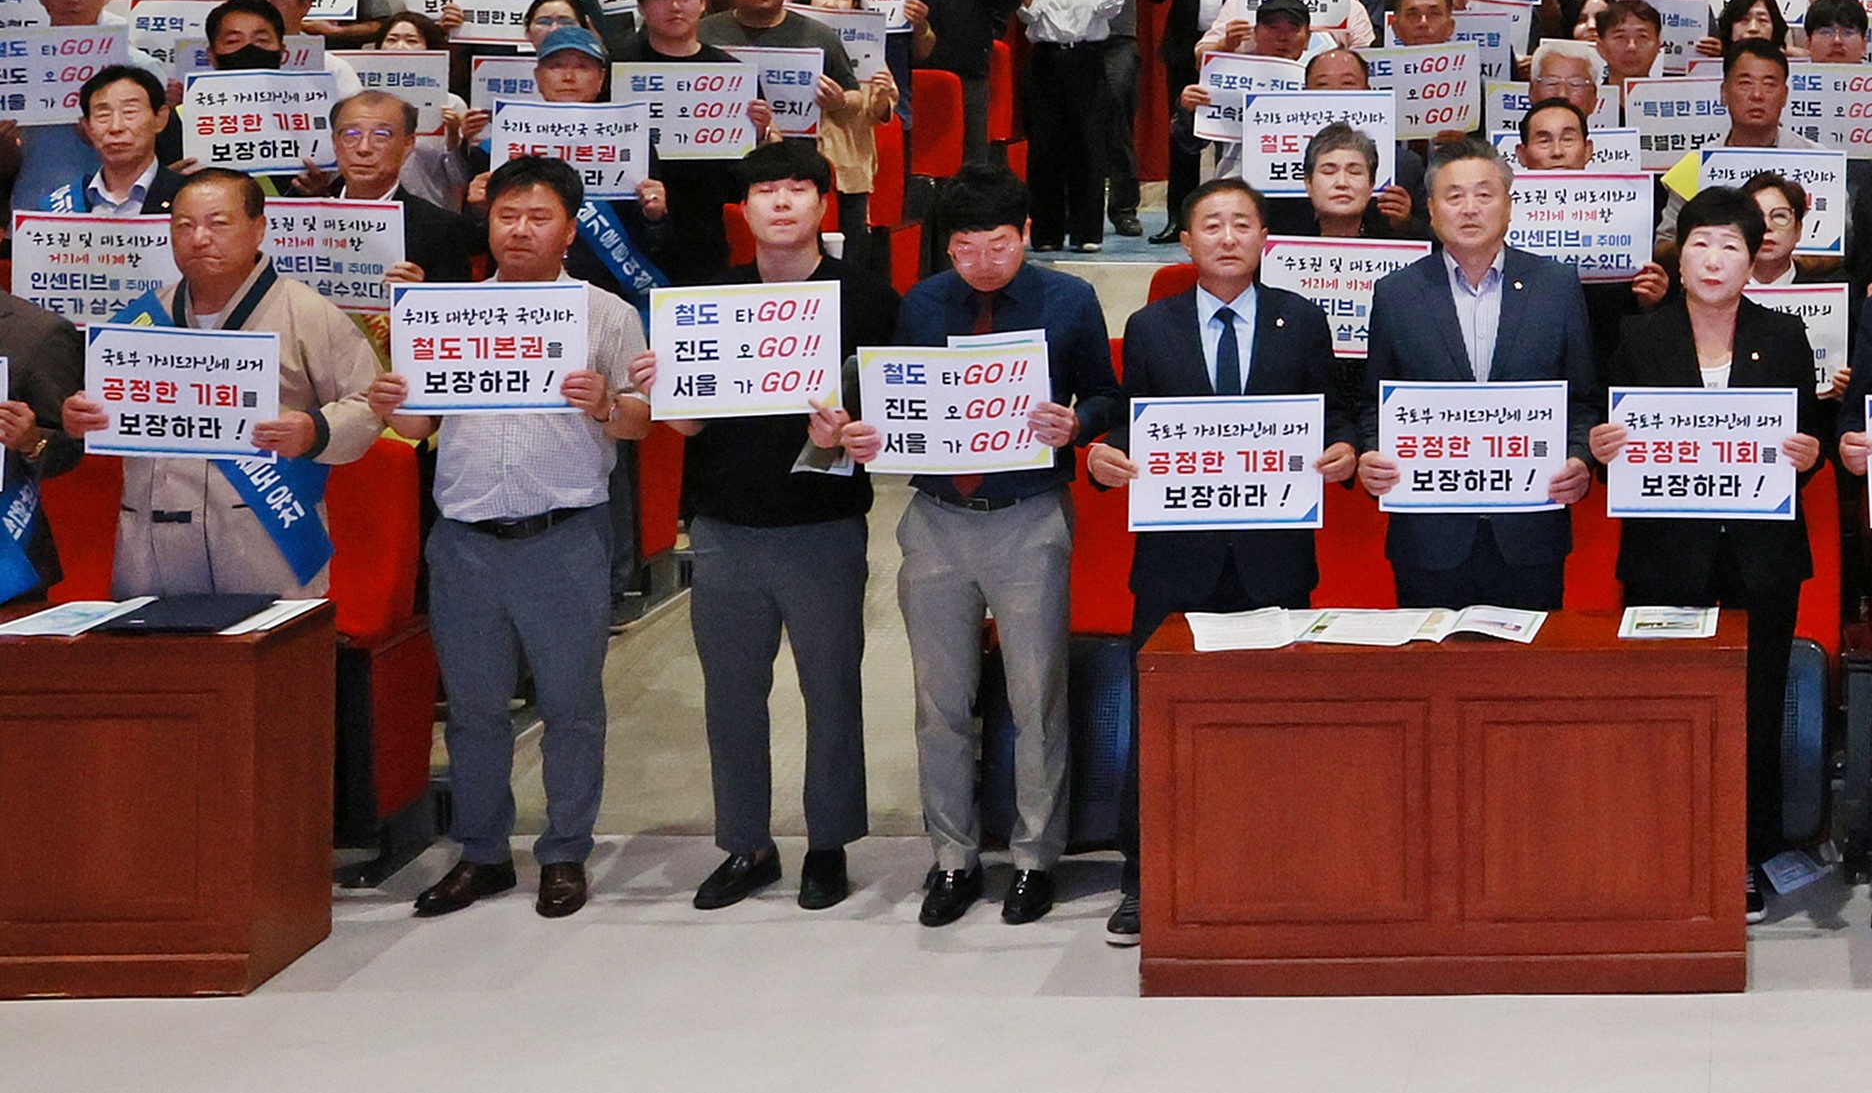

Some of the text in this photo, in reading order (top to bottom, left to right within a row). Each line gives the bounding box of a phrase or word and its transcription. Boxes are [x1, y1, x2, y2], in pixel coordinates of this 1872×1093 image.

[631, 76, 665, 92] 철도
[766, 70, 812, 85] 진도항
[1792, 75, 1822, 91] 철도
[772, 100, 813, 117] 유치!
[196, 113, 327, 135] 공정한 기회를
[211, 139, 318, 162] 보장하라 !
[402, 307, 577, 326] 우리도 대한민국 국민이다.
[675, 304, 719, 326] 철도
[412, 336, 563, 360] 철도기본권을
[675, 340, 720, 362] 진도
[101, 348, 263, 372] 국토부 가이드라인에 의거
[424, 370, 554, 394] 보장하라 !
[883, 363, 927, 385] 철도
[102, 378, 257, 407] 공정한 기회를
[673, 374, 717, 397] 서울
[885, 398, 928, 420] 진도
[1395, 406, 1552, 425] 국토부 가이드라인에 의거
[119, 413, 246, 440] 보장하라 !
[1147, 421, 1309, 441] 국토부 가이드라인에 의거
[884, 433, 927, 454] 서울
[1396, 436, 1548, 458] 공정한 기회를
[1626, 441, 1777, 463] 공정한 기회를
[1148, 450, 1304, 474] 공정한 기회를
[1412, 469, 1536, 492] 보장하라 !
[1641, 474, 1765, 498] 보장하라 !
[1164, 484, 1291, 509] 보장하라 !
